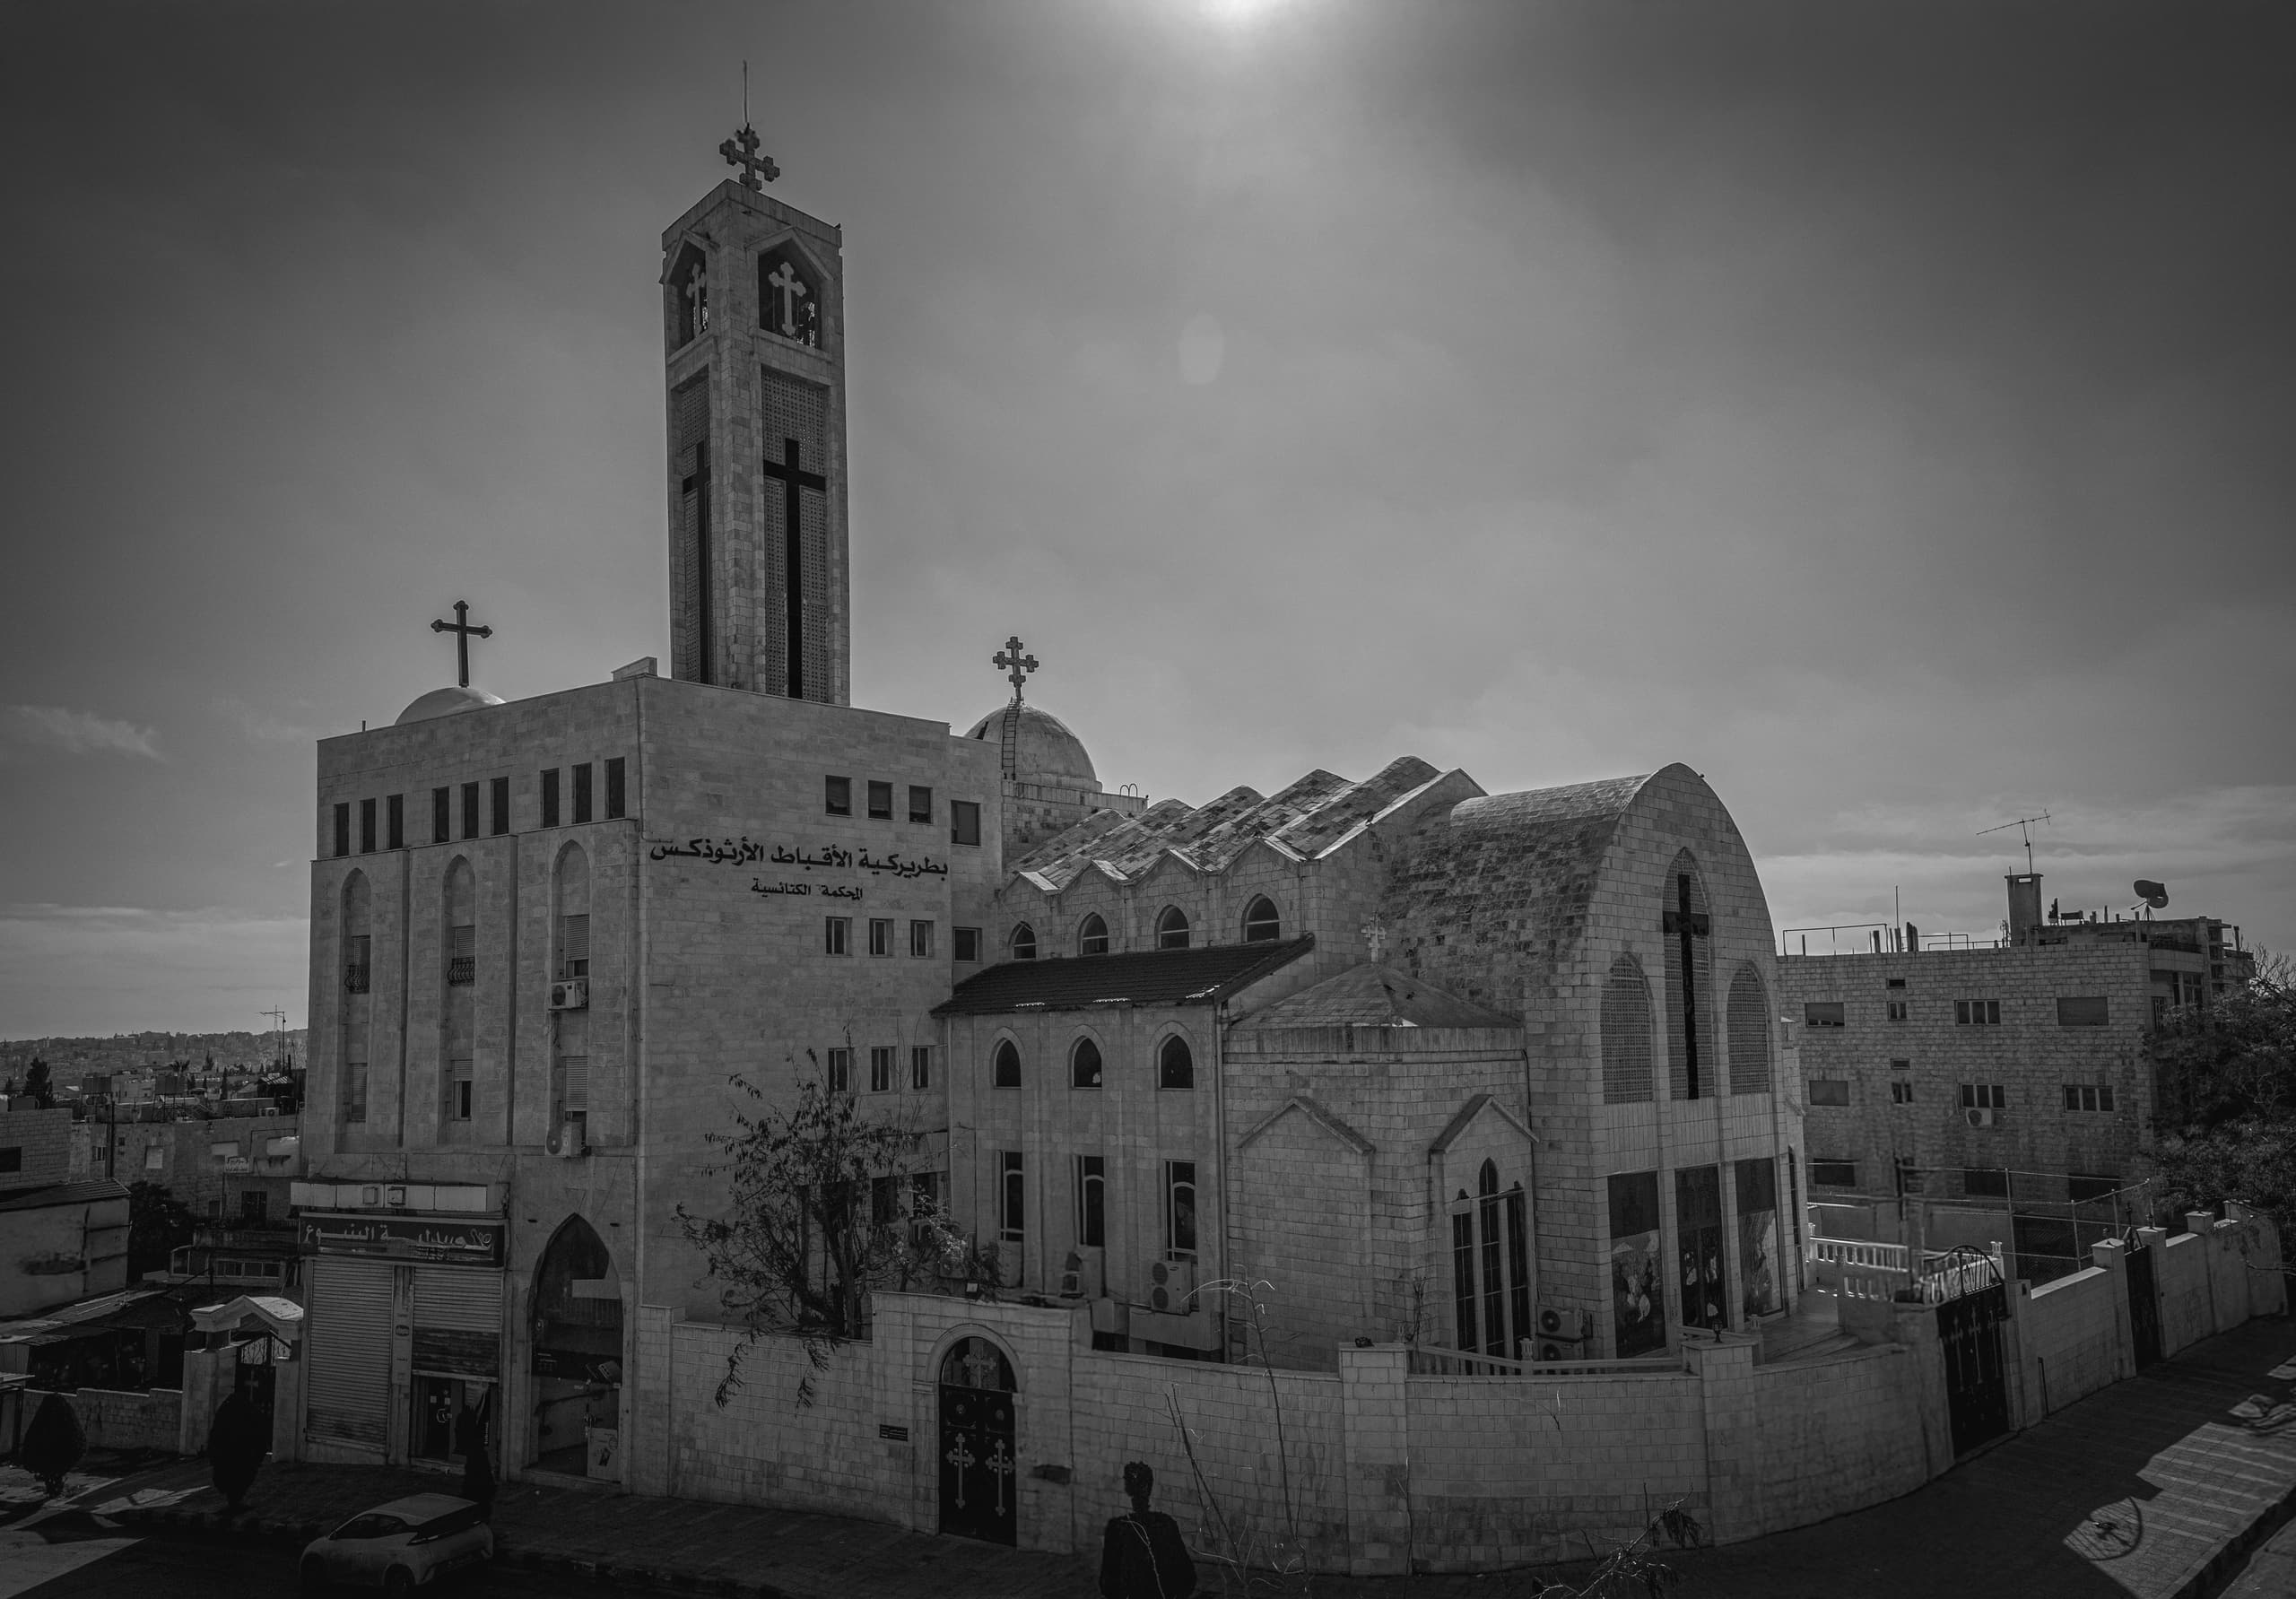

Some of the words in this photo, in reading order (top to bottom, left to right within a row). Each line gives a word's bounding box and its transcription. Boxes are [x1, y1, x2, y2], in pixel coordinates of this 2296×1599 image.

[649, 836, 764, 866] الأرثوذكس
[770, 844, 853, 872] الأقباط
[858, 847, 948, 882] بطريركية
[821, 884, 863, 901] المحكمة
